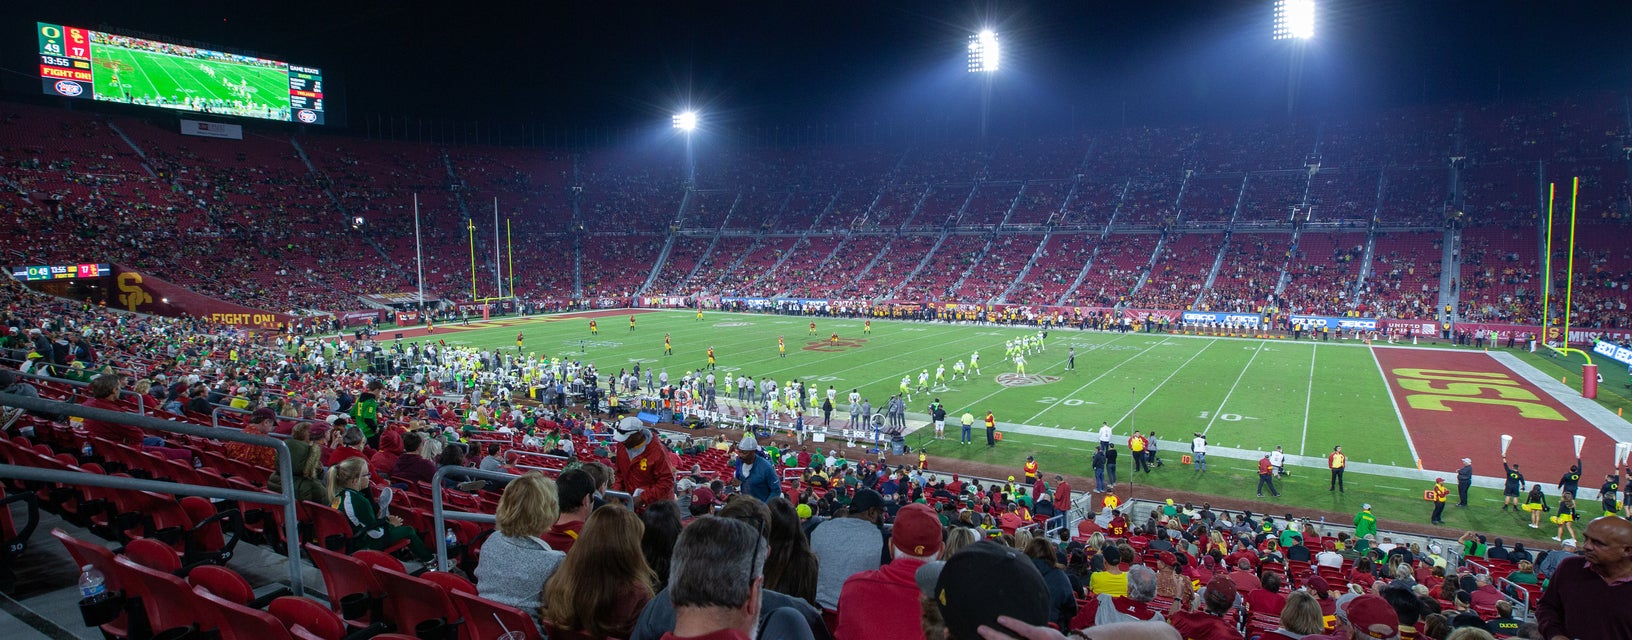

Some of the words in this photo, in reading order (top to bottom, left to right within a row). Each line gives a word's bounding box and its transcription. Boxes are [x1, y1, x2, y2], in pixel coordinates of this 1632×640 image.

[44, 43, 60, 53] 49
[72, 47, 84, 56] 17
[41, 56, 70, 66] 13:55
[43, 67, 73, 77] FIGHT
[75, 72, 91, 80] ON!
[39, 267, 48, 275] 49
[212, 313, 250, 325] FIGHT
[253, 314, 275, 325] ON!
[1184, 313, 1216, 321] GEICO
[1339, 319, 1376, 328] GEICO
[1391, 368, 1569, 422] USC
[1198, 411, 1243, 421] 10
[1114, 527, 1123, 535] 55
[10, 543, 23, 552] 30
[221, 551, 231, 559] 29
